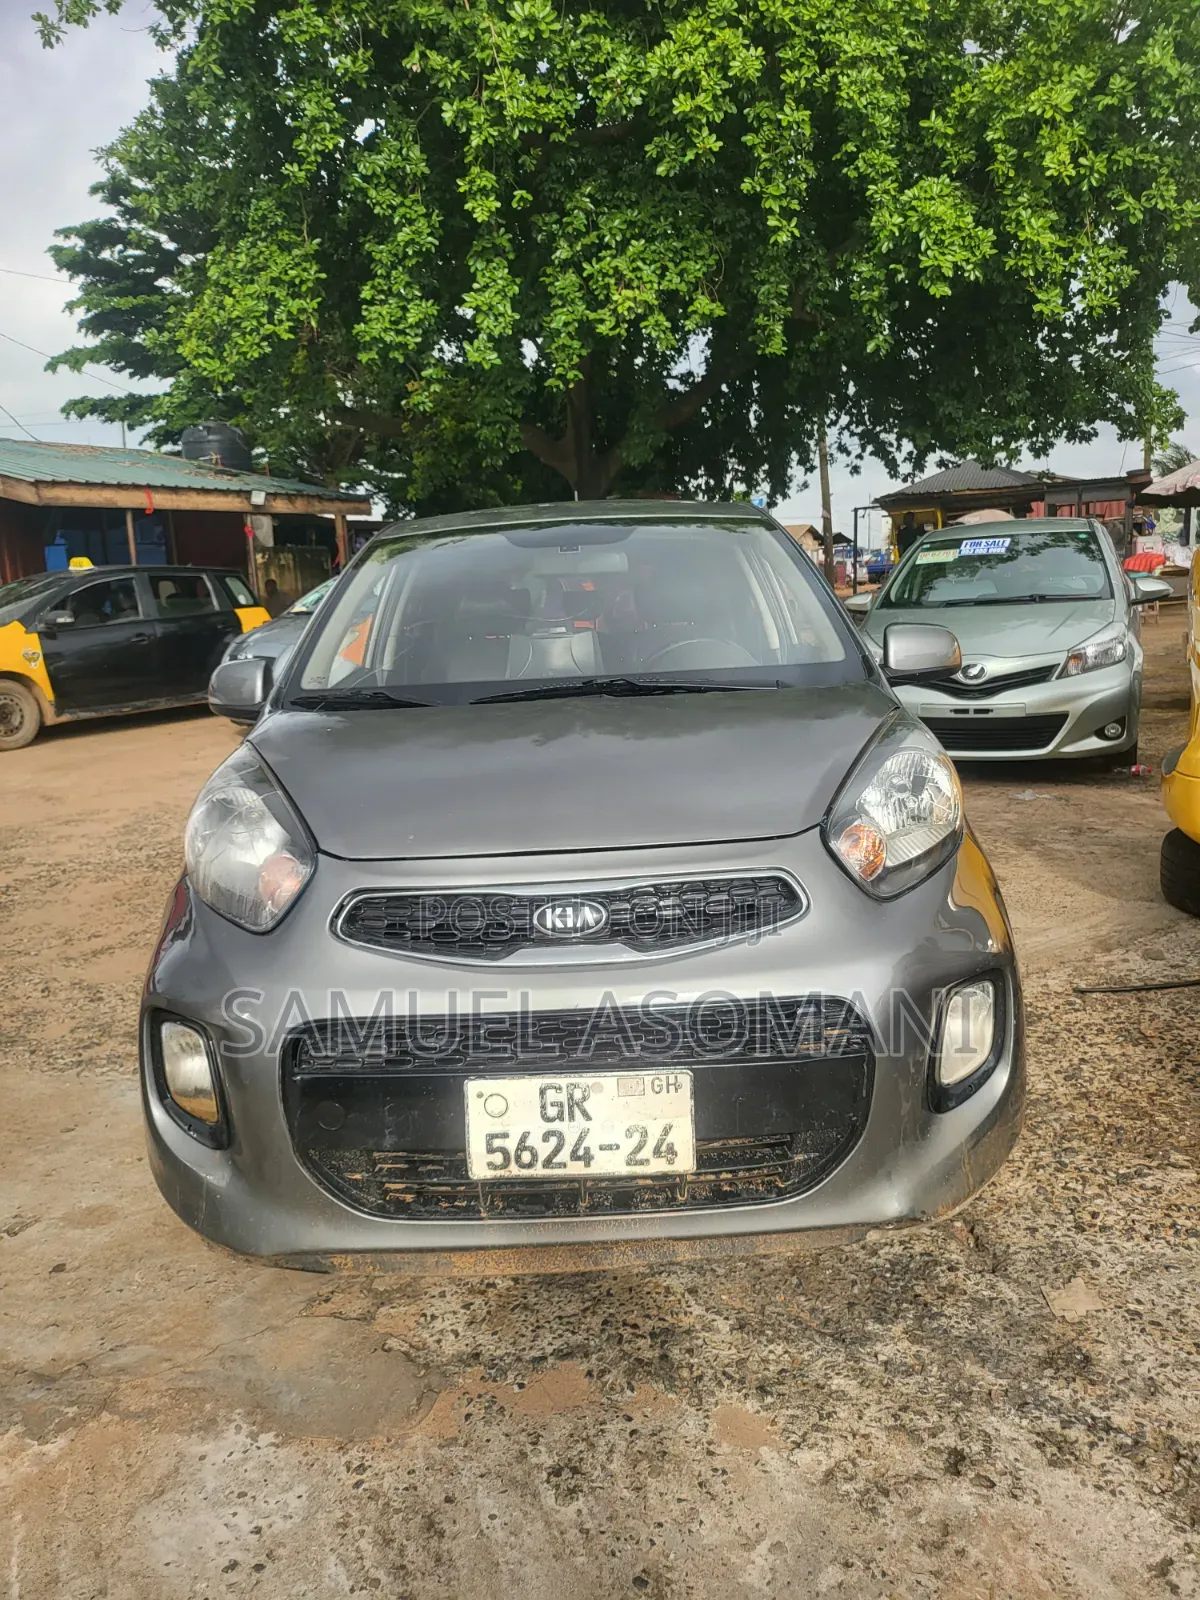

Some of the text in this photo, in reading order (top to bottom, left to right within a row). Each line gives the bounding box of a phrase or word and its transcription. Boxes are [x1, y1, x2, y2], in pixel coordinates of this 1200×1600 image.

[984, 539, 1008, 547] SALE
[544, 906, 597, 929] KIA
[650, 1075, 682, 1095] GH
[538, 1082, 593, 1123] GR
[485, 1123, 678, 1171] 5624-24
